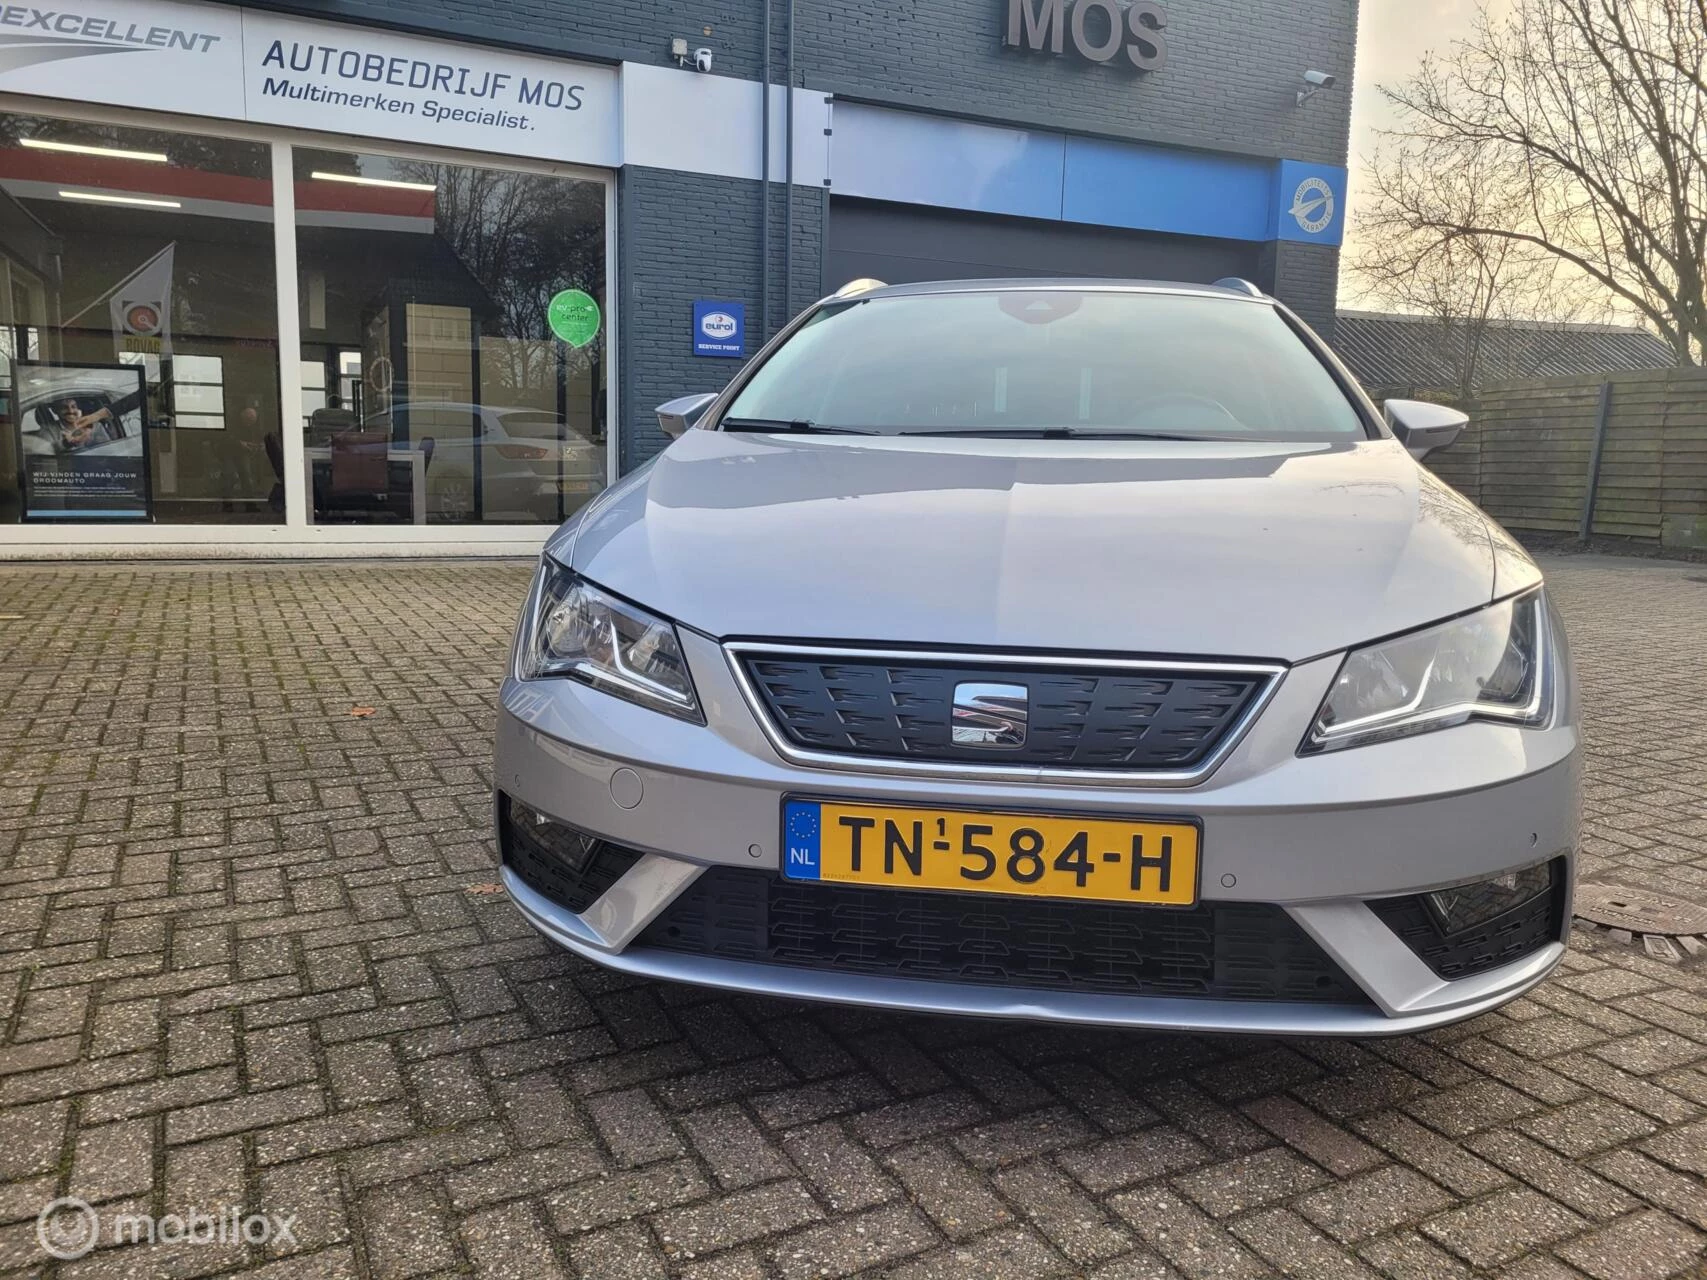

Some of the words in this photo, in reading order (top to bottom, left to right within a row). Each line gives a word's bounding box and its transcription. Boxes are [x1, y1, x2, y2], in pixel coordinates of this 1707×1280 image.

[0, 5, 221, 53] EXCELLENT
[1007, 0, 1169, 72] MOS
[261, 39, 511, 99] AUTOBEDRIJF
[518, 77, 585, 111] MOS
[262, 77, 415, 115] Multimerken
[421, 100, 535, 131] Specialist.
[705, 322, 733, 331] eurol
[33, 477, 86, 485] DROOMAUTO
[49, 471, 81, 479] VINDEN
[790, 847, 816, 867] NL
